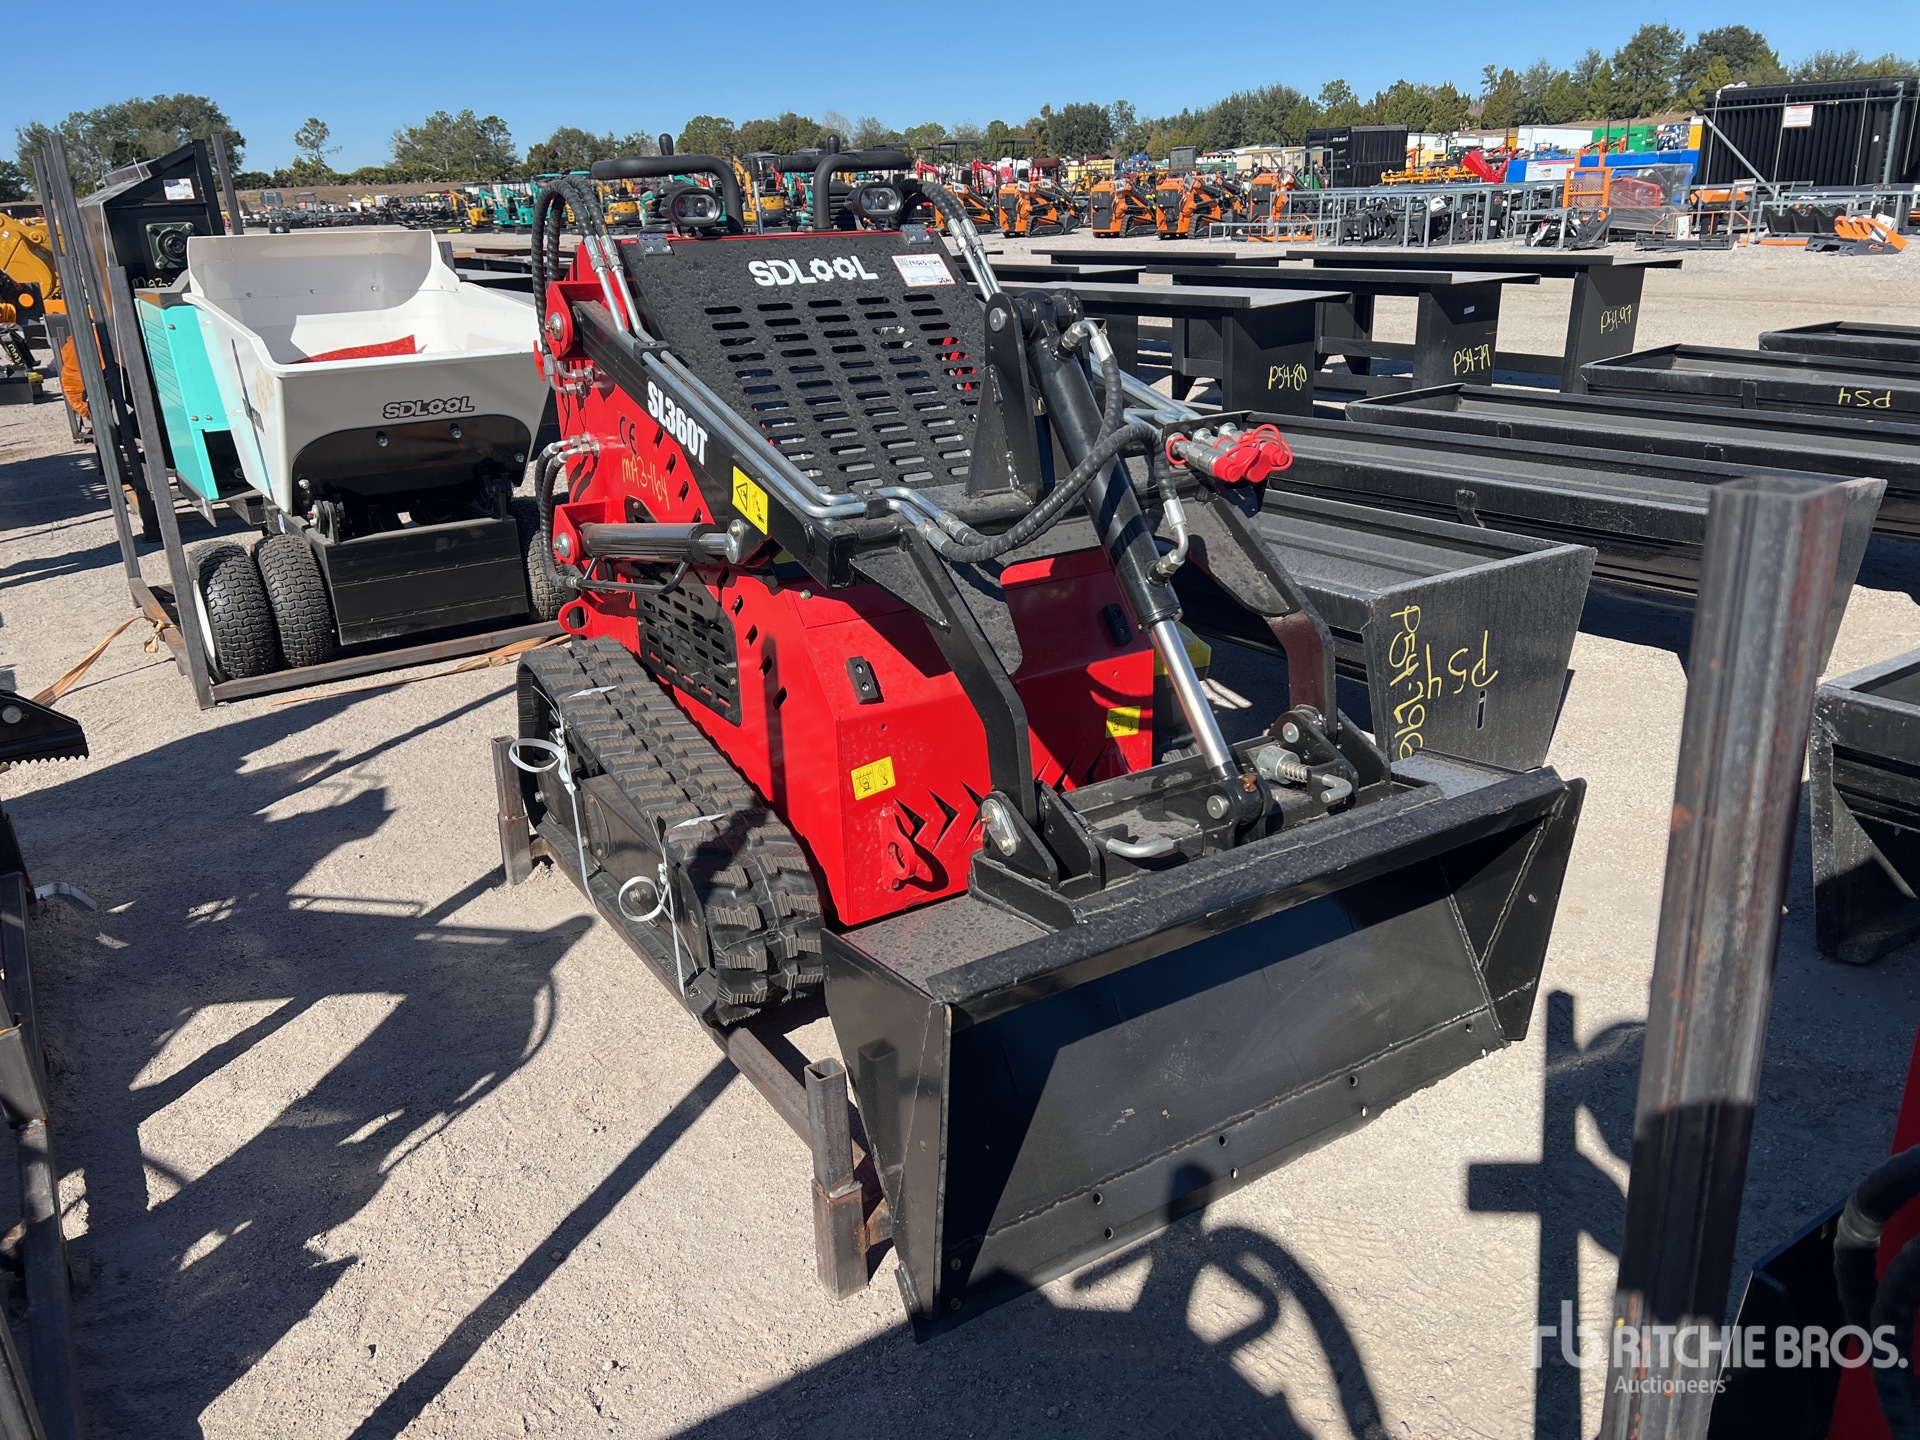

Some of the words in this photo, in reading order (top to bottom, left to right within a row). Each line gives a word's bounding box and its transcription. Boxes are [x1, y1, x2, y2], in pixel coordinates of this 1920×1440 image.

[748, 255, 880, 287] SDLOOL
[1453, 343, 1491, 376] P54-79
[1267, 363, 1308, 391] P54-80
[383, 395, 475, 419] SDLOOL
[647, 380, 708, 466] SL360T
